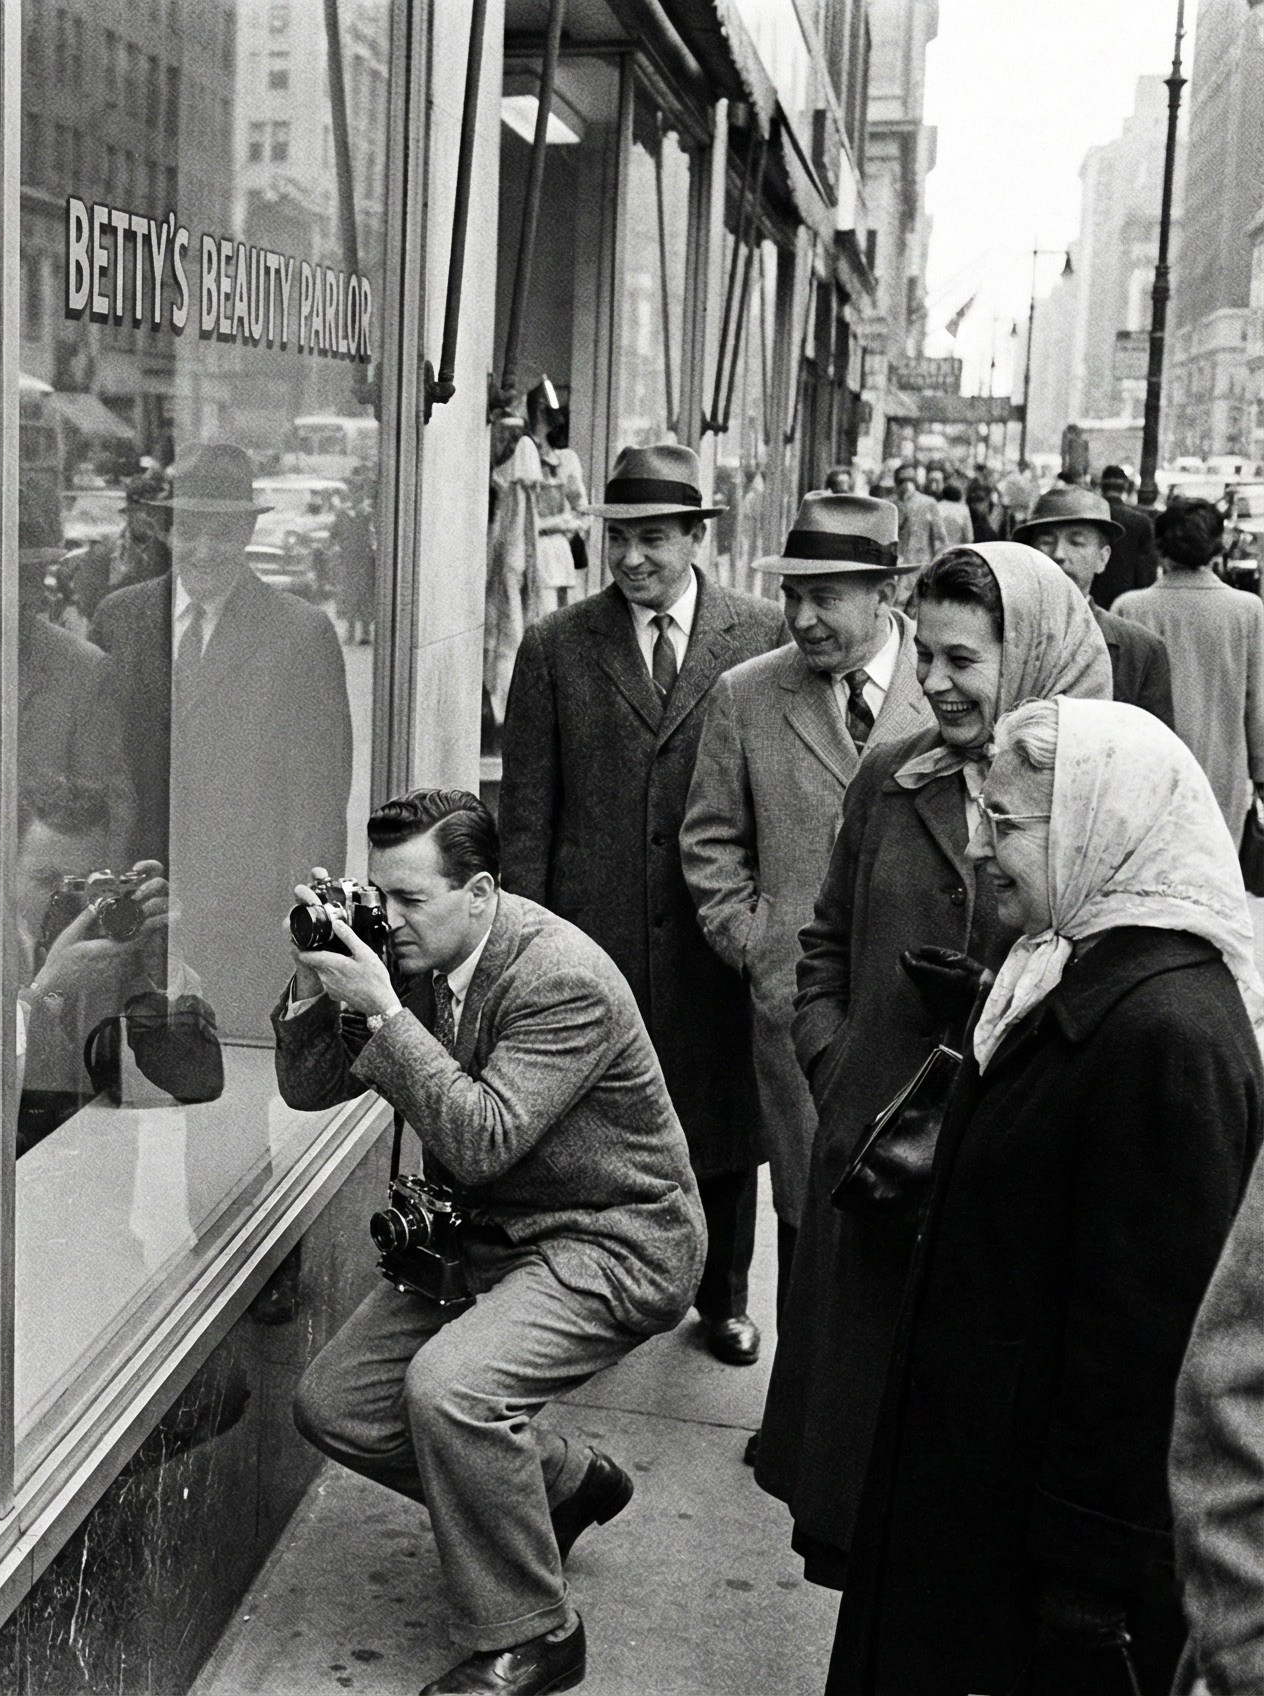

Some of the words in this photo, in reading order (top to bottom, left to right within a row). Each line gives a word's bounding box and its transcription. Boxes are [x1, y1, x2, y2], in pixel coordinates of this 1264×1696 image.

[68, 196, 189, 328] BETTY'S
[200, 233, 295, 343] BEAUTY
[299, 260, 372, 356] PARLOR
